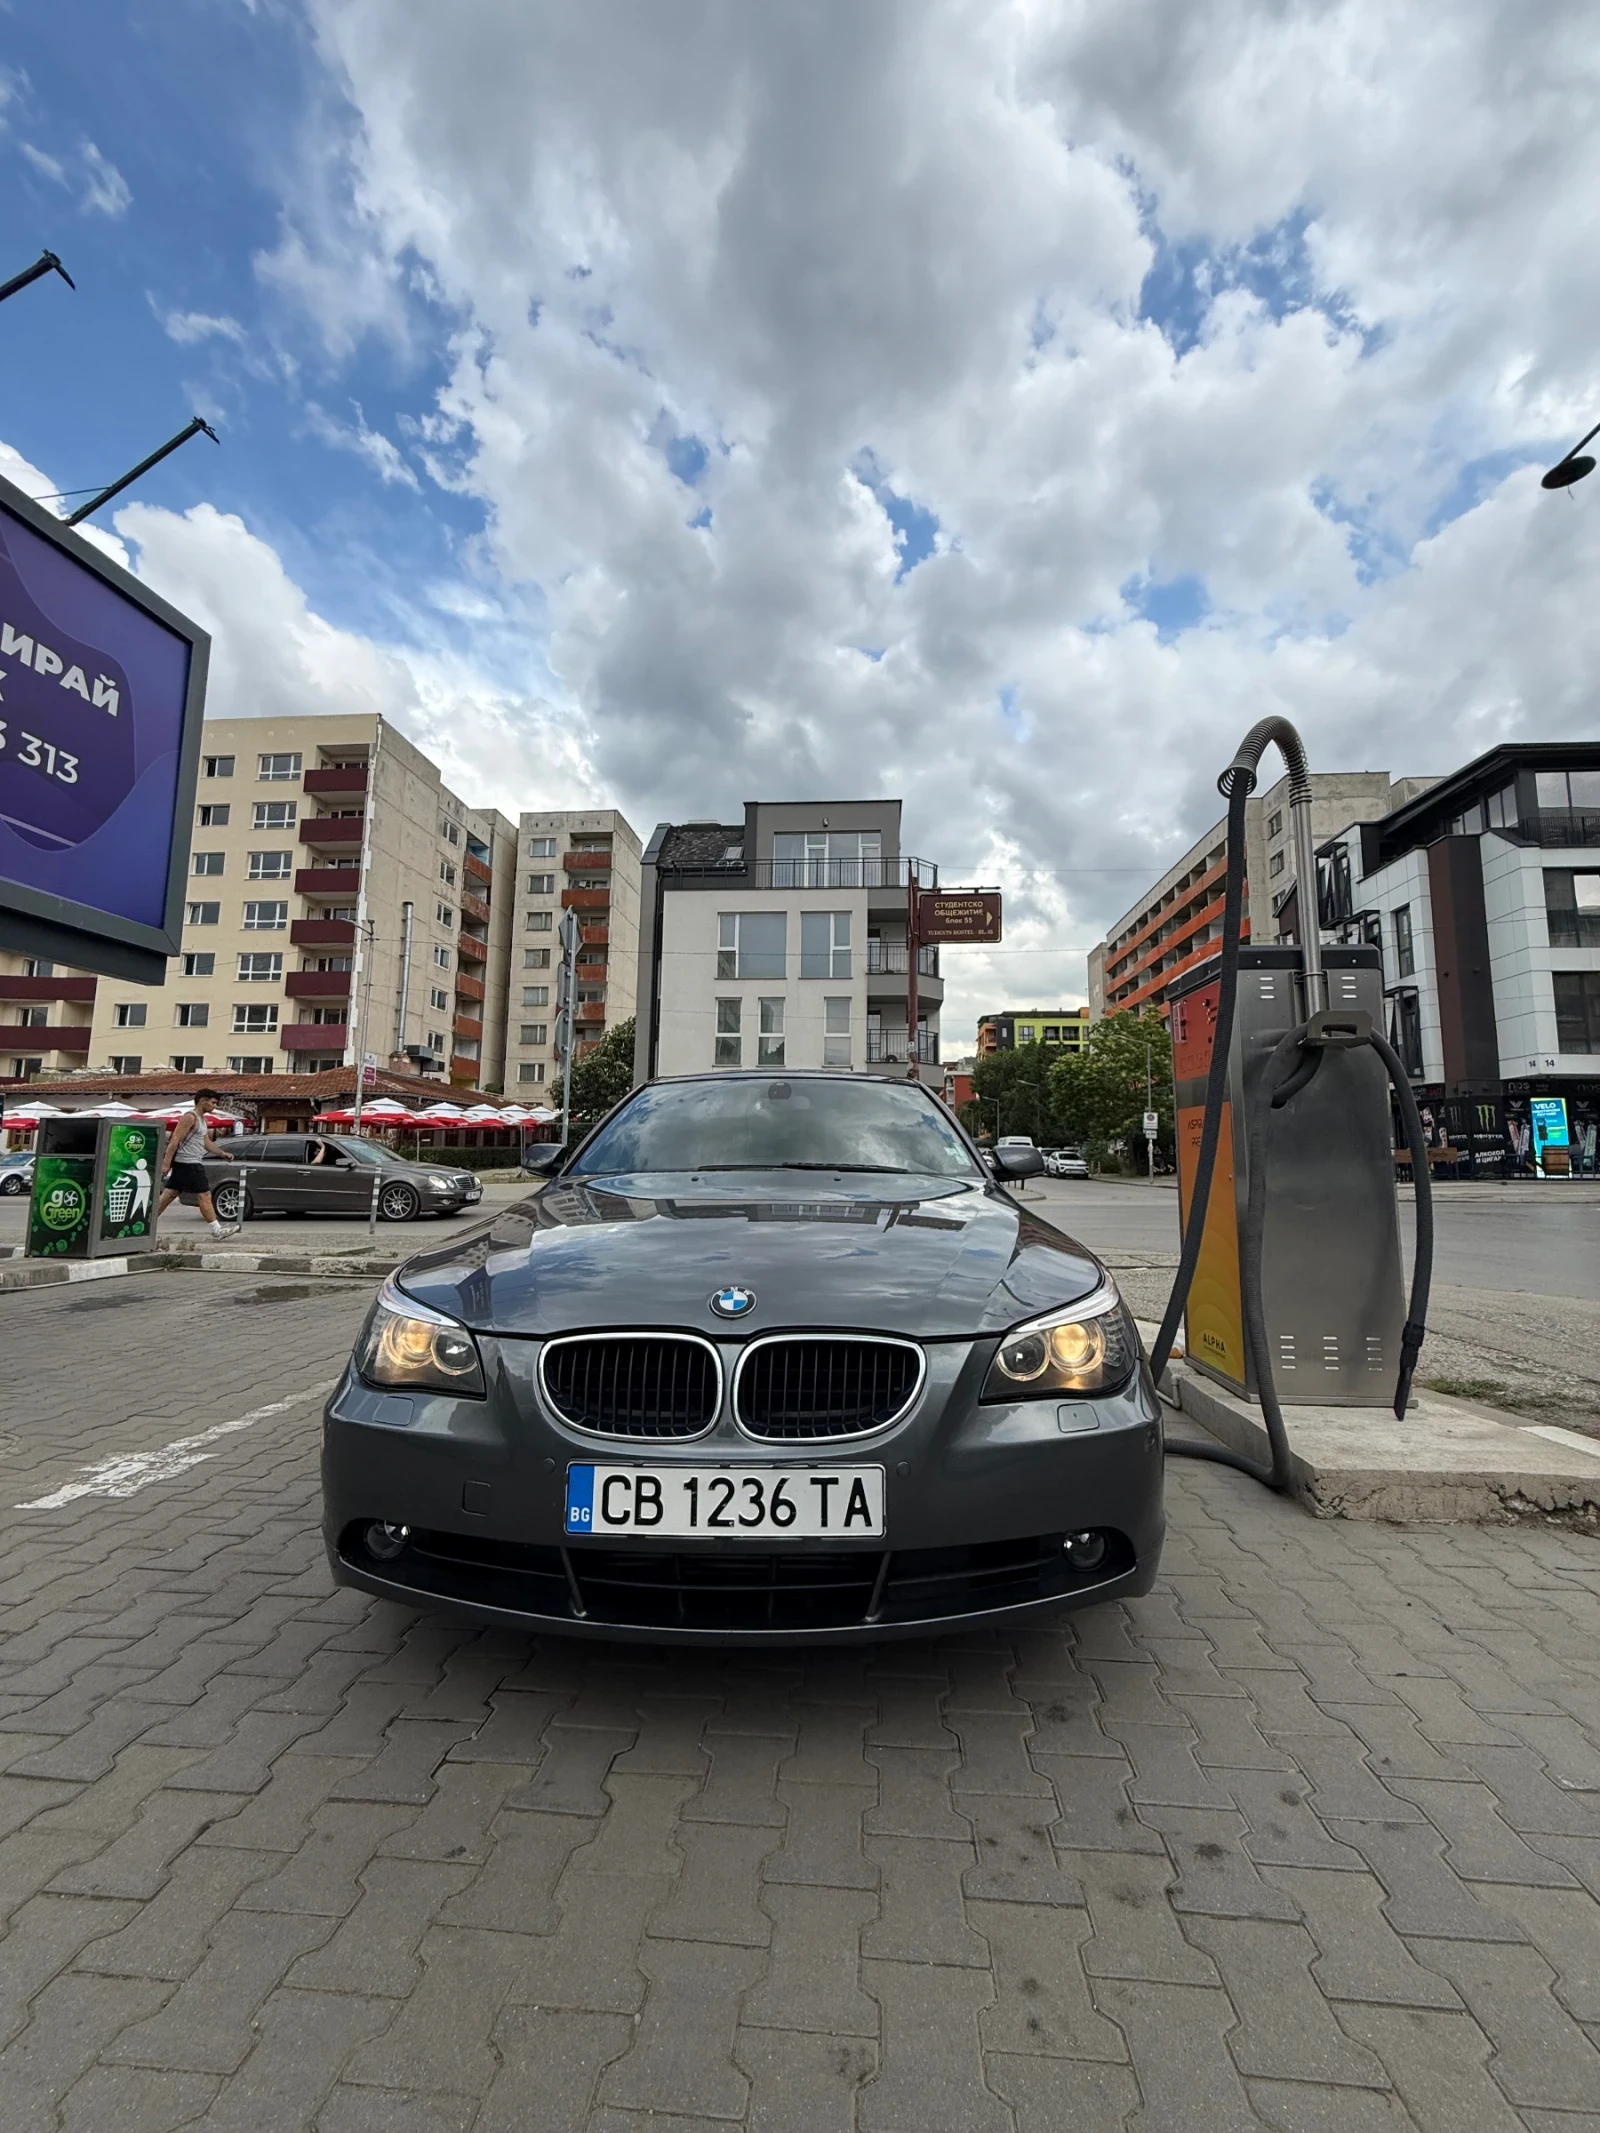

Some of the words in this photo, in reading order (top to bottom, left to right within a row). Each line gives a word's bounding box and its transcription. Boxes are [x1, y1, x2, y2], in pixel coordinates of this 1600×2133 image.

[17, 731, 79, 784] 313
[934, 901, 984, 909] СТУДЕНТСКО
[934, 909, 984, 917] ОБЩЕЖИТИЕ
[1529, 1060, 1536, 1068] 14
[1535, 1102, 1556, 1110] VELO
[1475, 1149, 1505, 1158] АЛКОХОЛ
[43, 1202, 80, 1220] Green
[716, 1286, 753, 1296] BMW
[1203, 1333, 1226, 1353] ALPHA
[601, 1475, 664, 1526] CB
[683, 1476, 797, 1527] 1236
[810, 1476, 873, 1527] TA
[570, 1507, 590, 1523] BG
